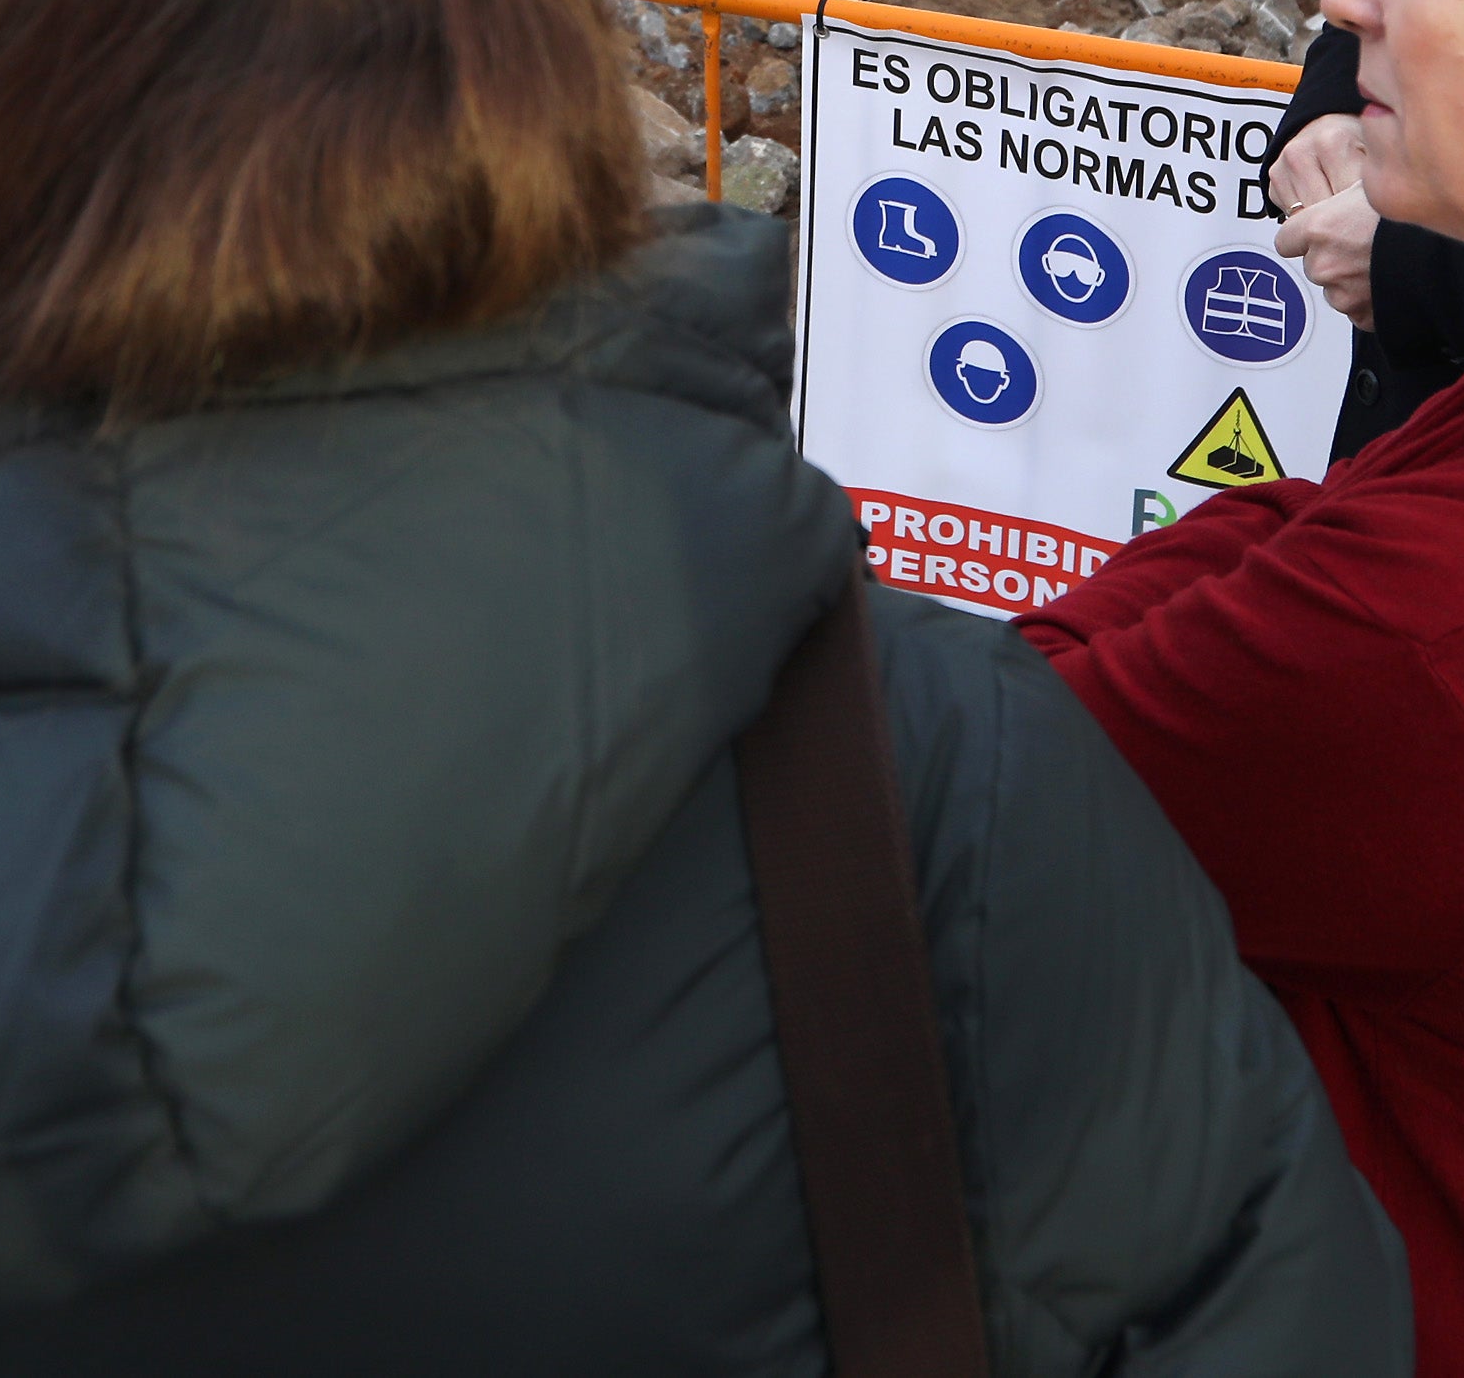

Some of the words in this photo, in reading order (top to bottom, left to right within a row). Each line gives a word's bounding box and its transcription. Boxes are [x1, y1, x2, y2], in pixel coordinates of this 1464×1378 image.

[851, 47, 911, 94] ES
[927, 62, 1273, 165] OBLIGATORIO
[892, 108, 983, 162] LAS
[1000, 129, 1218, 214] NORMAS
